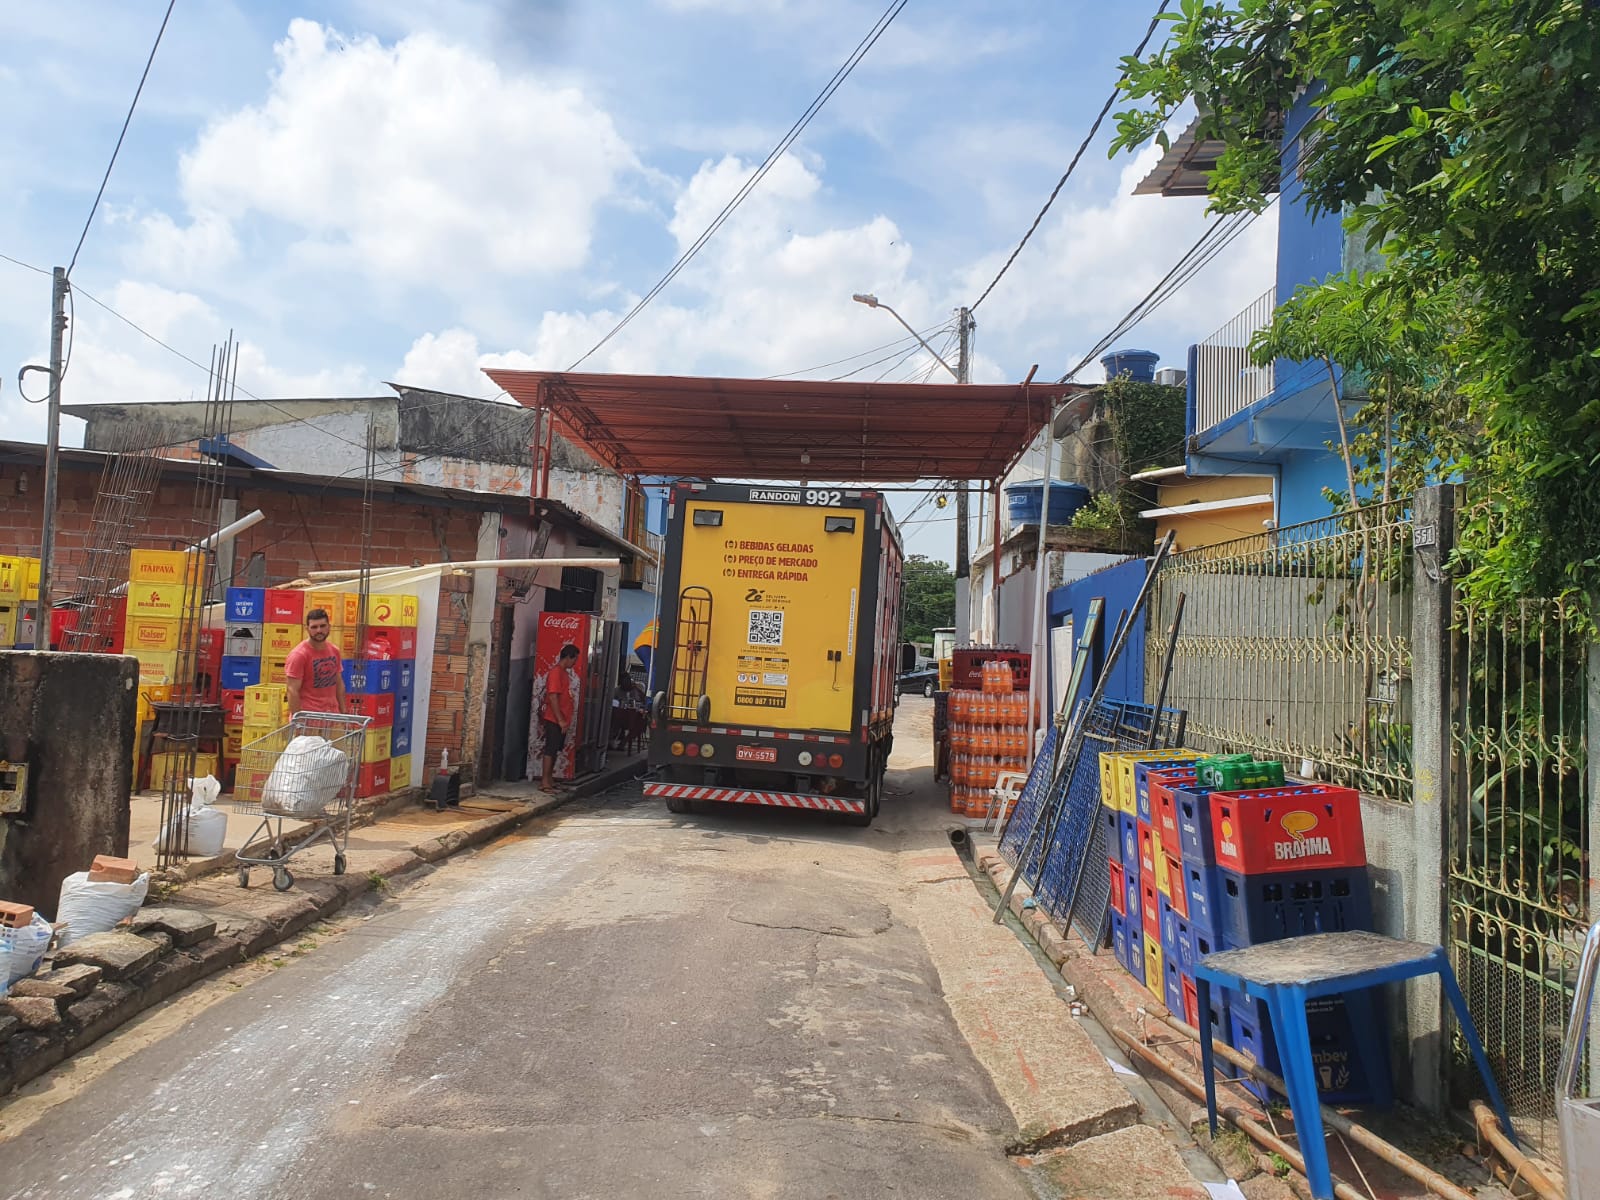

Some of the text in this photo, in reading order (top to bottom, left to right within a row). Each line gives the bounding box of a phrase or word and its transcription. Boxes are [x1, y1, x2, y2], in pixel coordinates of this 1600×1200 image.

[751, 491, 798, 501] RANDON
[806, 490, 841, 506] 992
[739, 540, 814, 553] BEBIDAS GELADAS
[738, 555, 818, 568] PREÇO DE MERCADO
[140, 564, 174, 574] ITAIPAVA
[737, 569, 808, 582] ENTREGA RÁPIDA
[140, 629, 165, 638] Kaiser
[769, 698, 784, 706] 1111
[1274, 836, 1332, 860] BRAHMA
[1312, 1050, 1348, 1063] mbev
